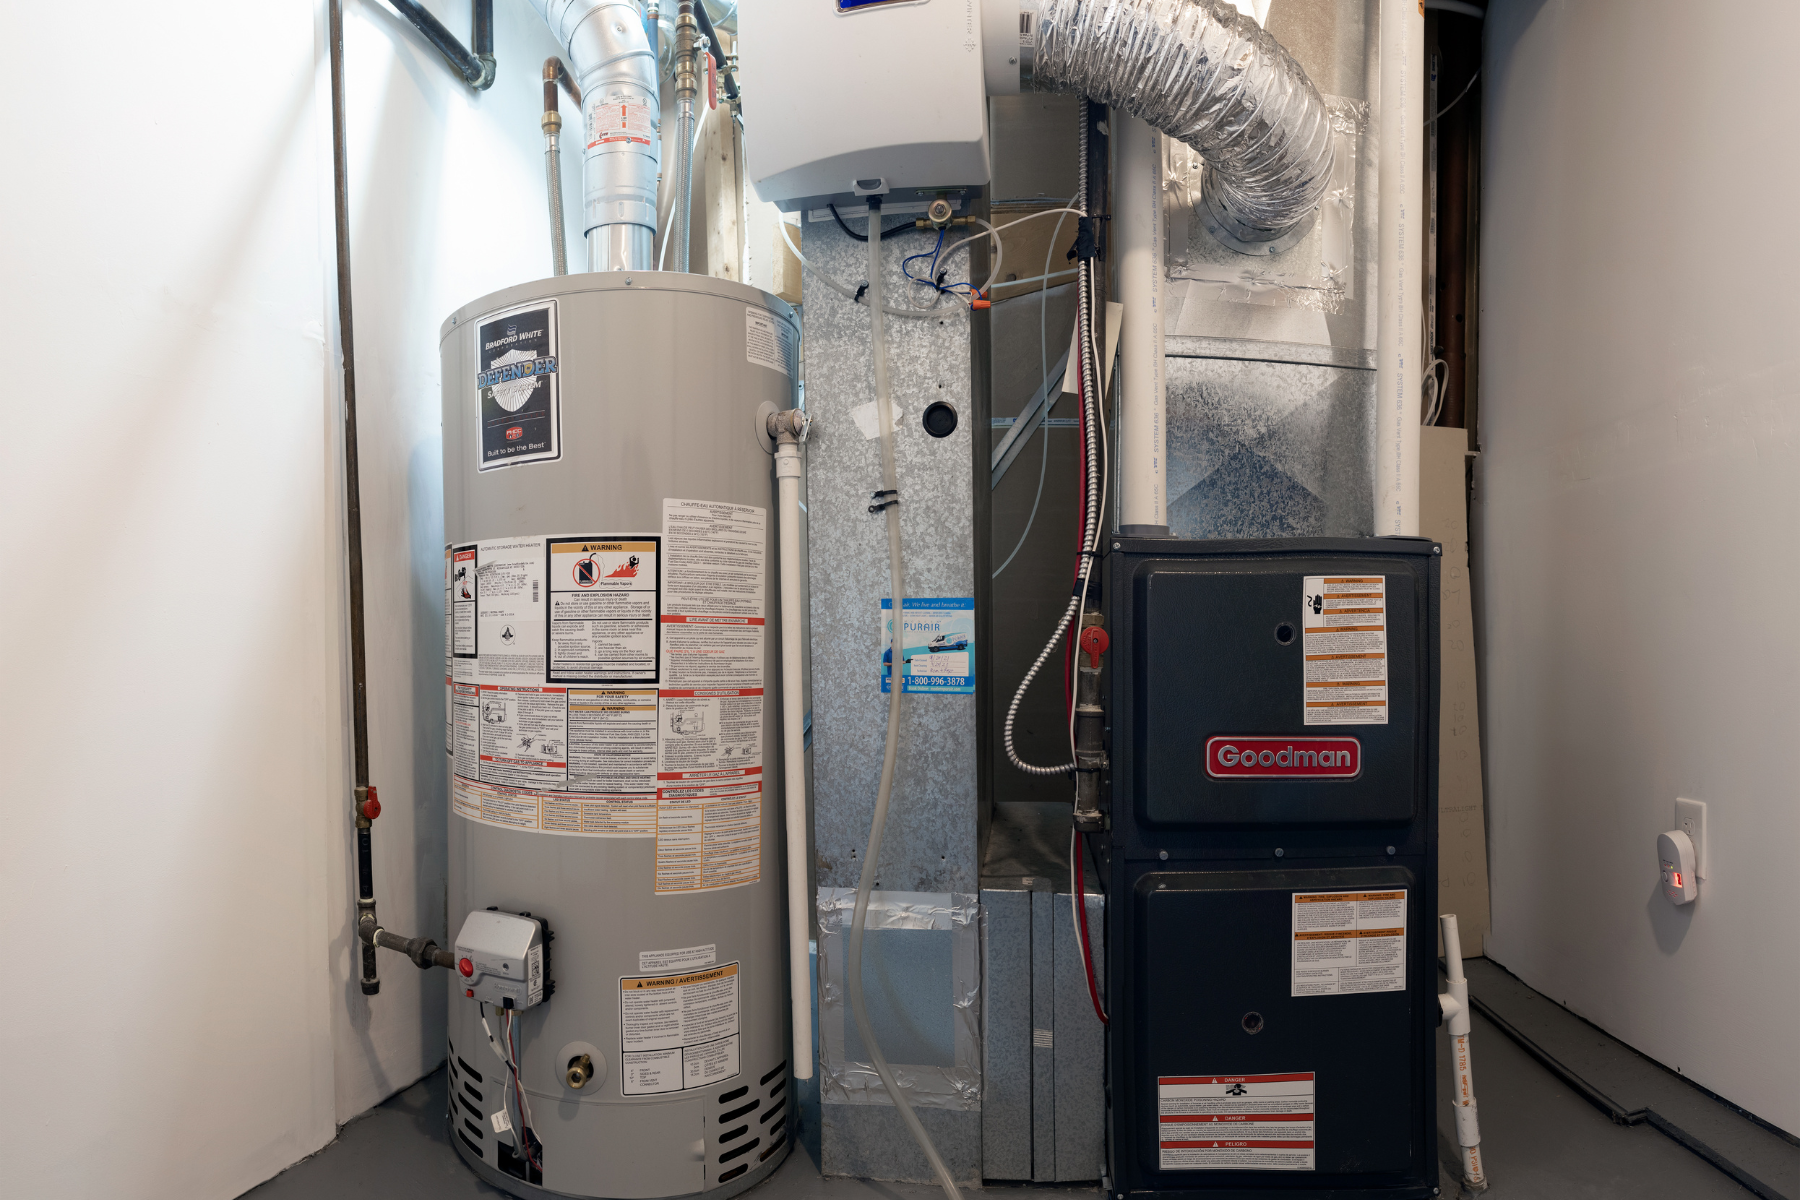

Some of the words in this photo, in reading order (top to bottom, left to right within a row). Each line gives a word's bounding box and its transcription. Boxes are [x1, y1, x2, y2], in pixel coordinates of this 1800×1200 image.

[486, 335, 518, 350] BRADFORD
[519, 330, 542, 340] WHITE
[478, 356, 558, 389] DEFENDER
[904, 623, 940, 631] PURAIR
[908, 677, 965, 685] 1-800-996-3878
[1218, 745, 1350, 767] Goodman
[646, 978, 674, 987] WARNING
[679, 970, 723, 984] AVERTISSEMENT
[1459, 1055, 1467, 1071] 1785
